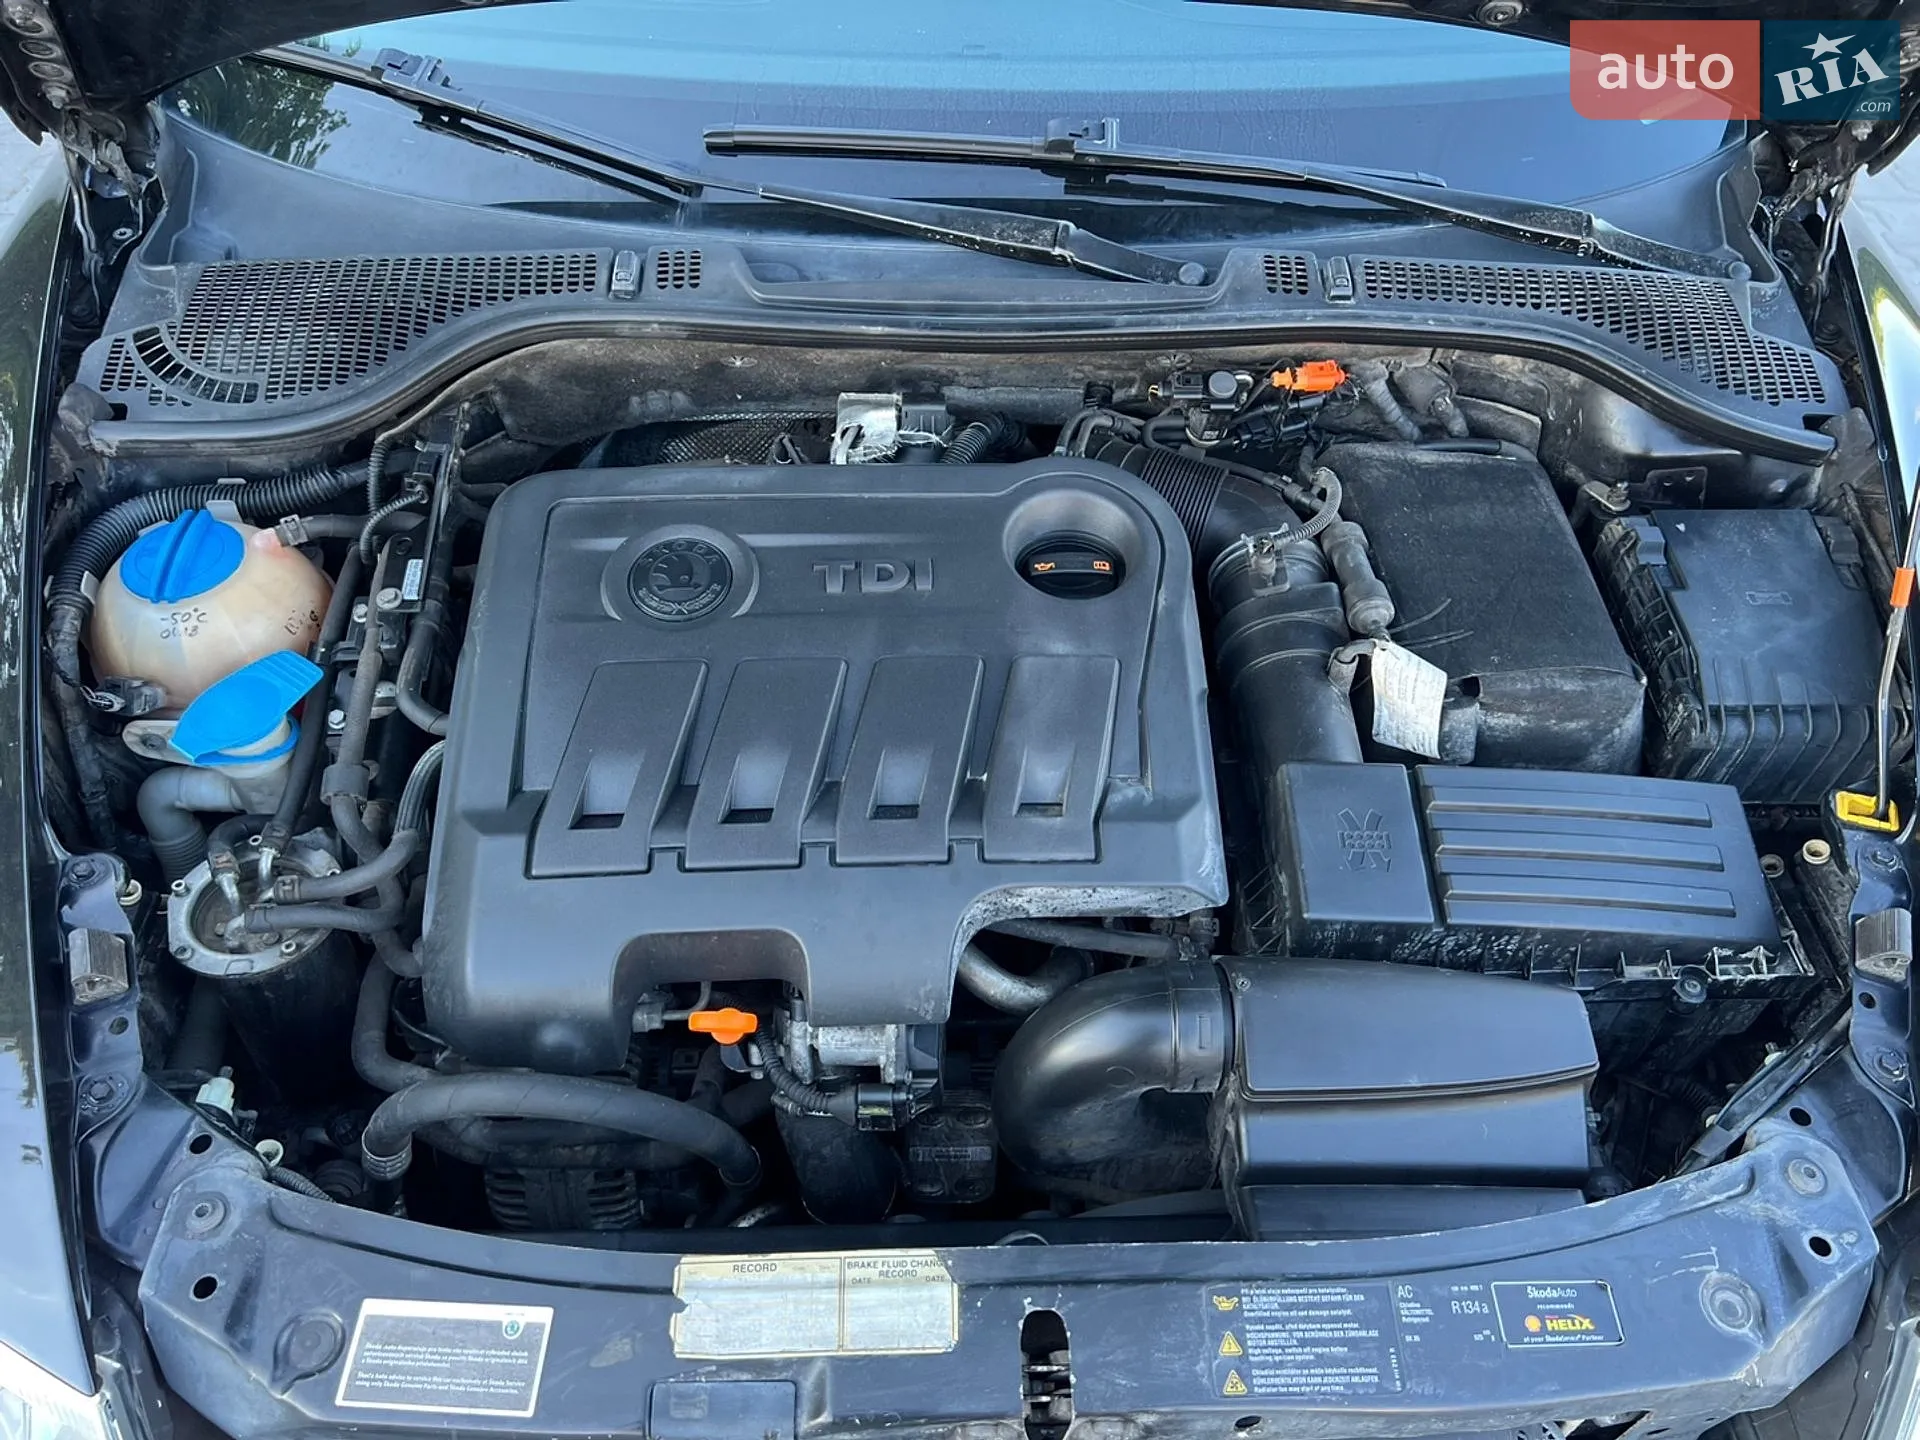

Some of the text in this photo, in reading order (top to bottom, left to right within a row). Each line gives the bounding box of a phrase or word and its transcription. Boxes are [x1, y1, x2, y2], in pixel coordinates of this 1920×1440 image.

[813, 557, 935, 594] TDI
[733, 1263, 777, 1273] RECORD
[847, 1260, 879, 1270] BRAKE
[881, 1259, 907, 1269] FLUID
[878, 1269, 917, 1278] RECORD
[1397, 1285, 1413, 1299] AC
[1545, 1317, 1595, 1332] HELIX
